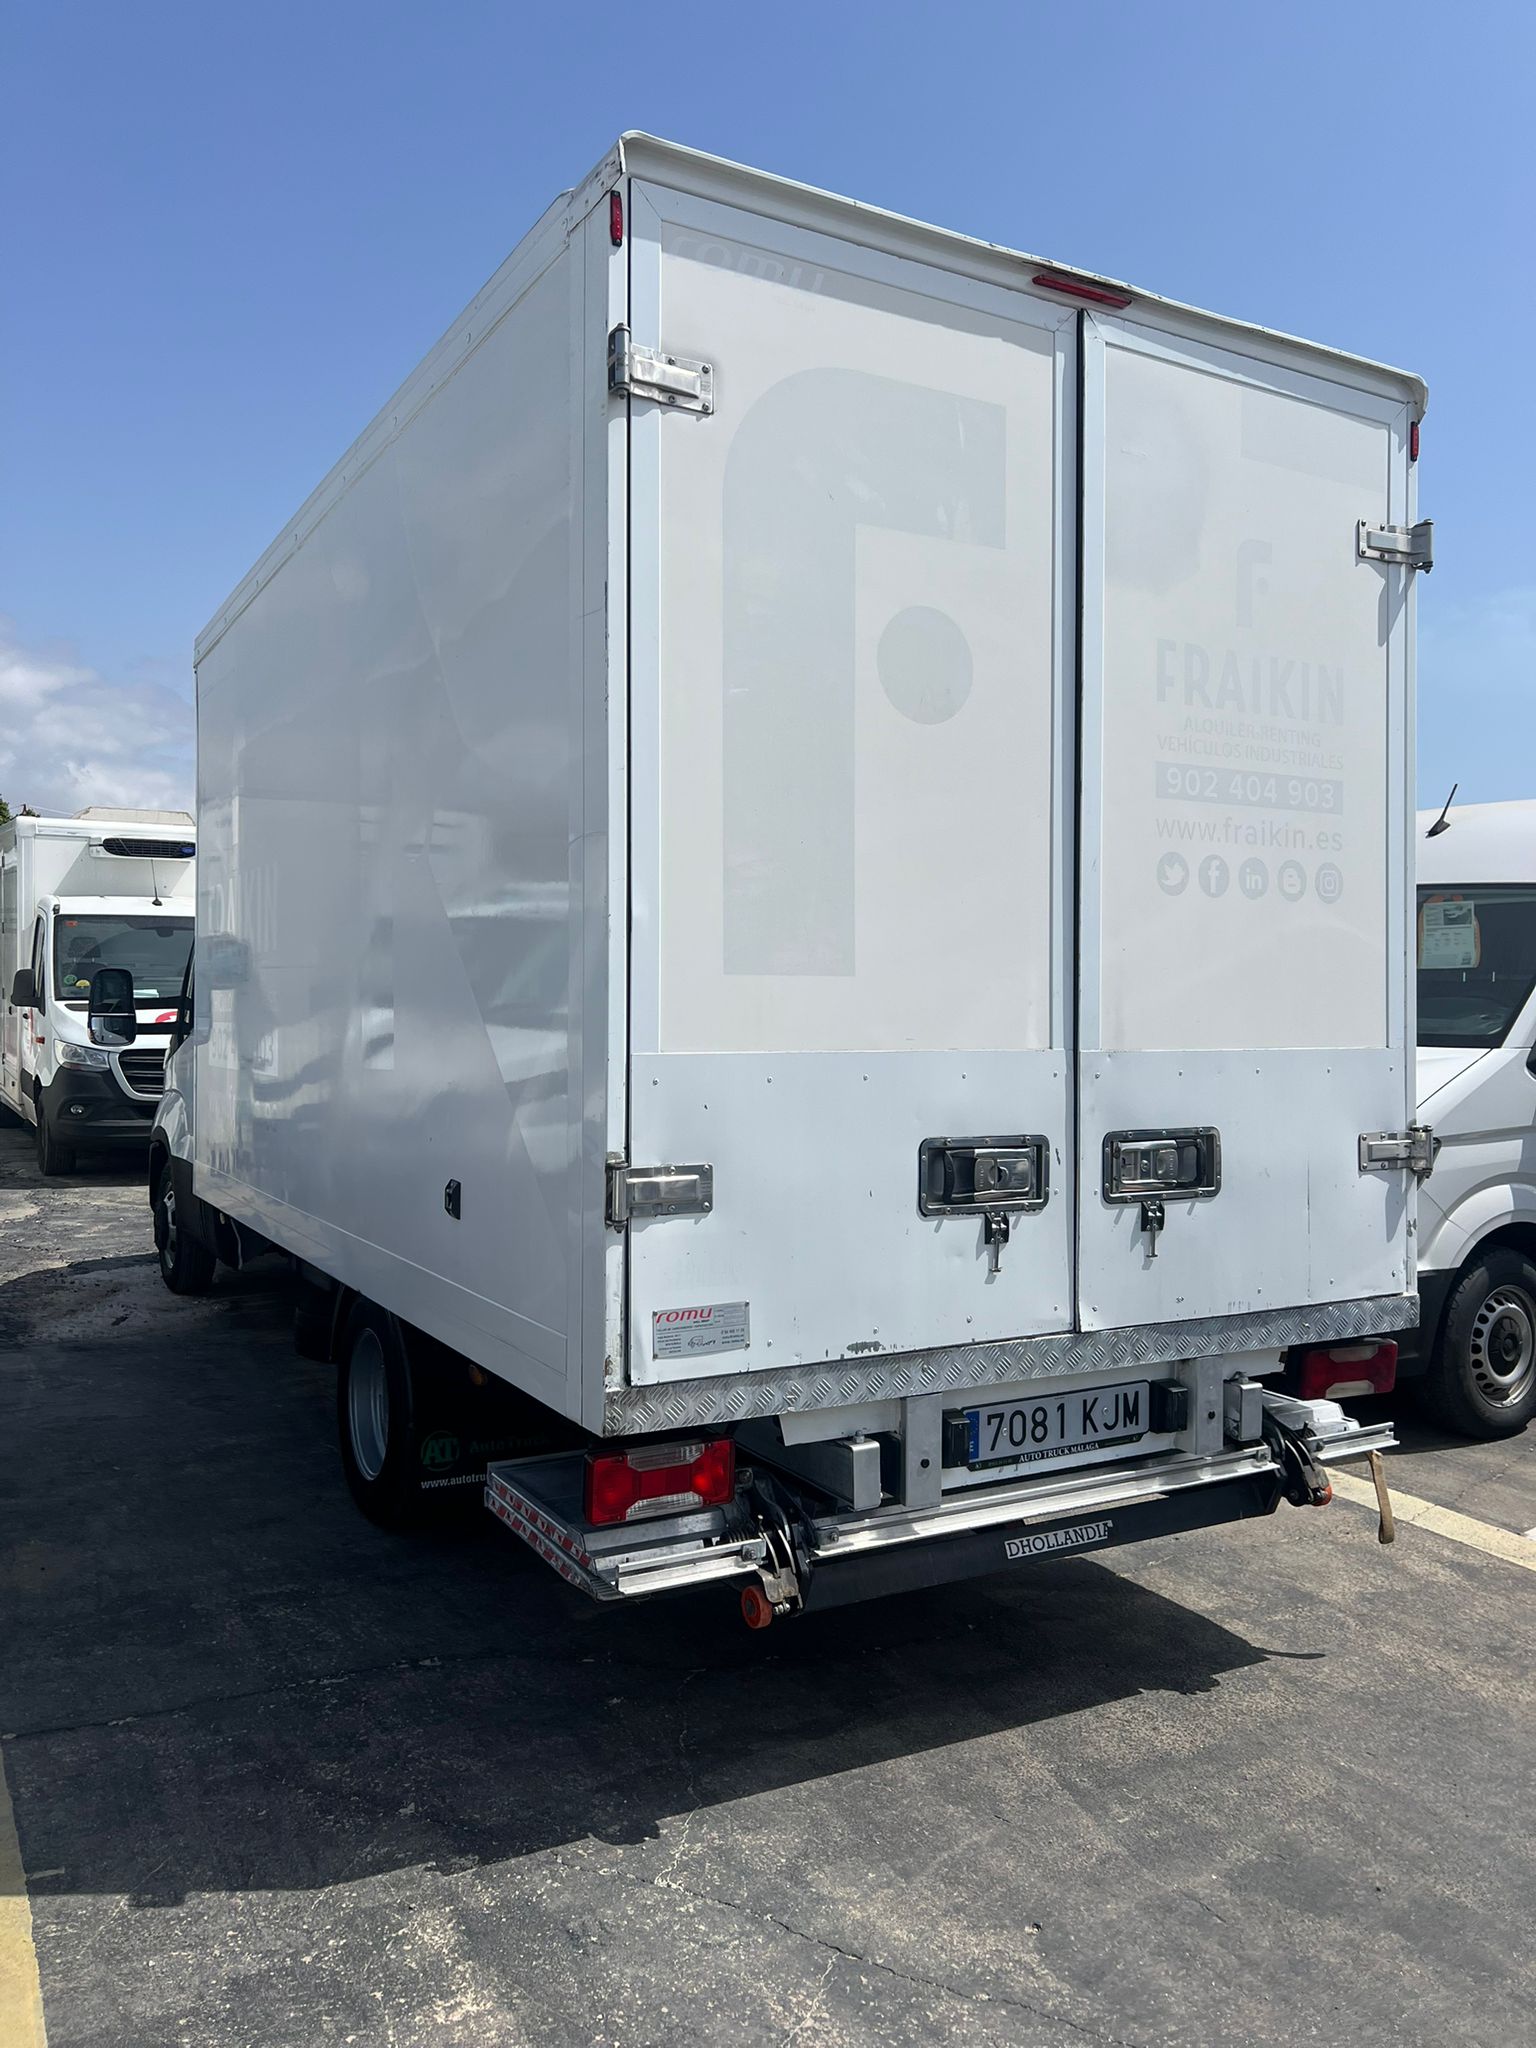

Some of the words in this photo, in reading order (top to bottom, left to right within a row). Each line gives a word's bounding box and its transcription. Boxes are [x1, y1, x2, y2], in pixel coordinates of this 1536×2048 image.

[1156, 638, 1344, 725] FRAIKIN
[1244, 743, 1344, 770] INDUSTRIALES
[1166, 767, 1218, 799] 902
[1229, 774, 1278, 803] 404
[1288, 780, 1335, 808] 903
[1155, 816, 1344, 852] www.fraikin.es
[656, 1307, 713, 1324] romu
[987, 1402, 1066, 1452] 7081
[1081, 1390, 1140, 1436] KJM
[1018, 1451, 1042, 1463] AUTO
[1042, 1446, 1070, 1459] TRUCK
